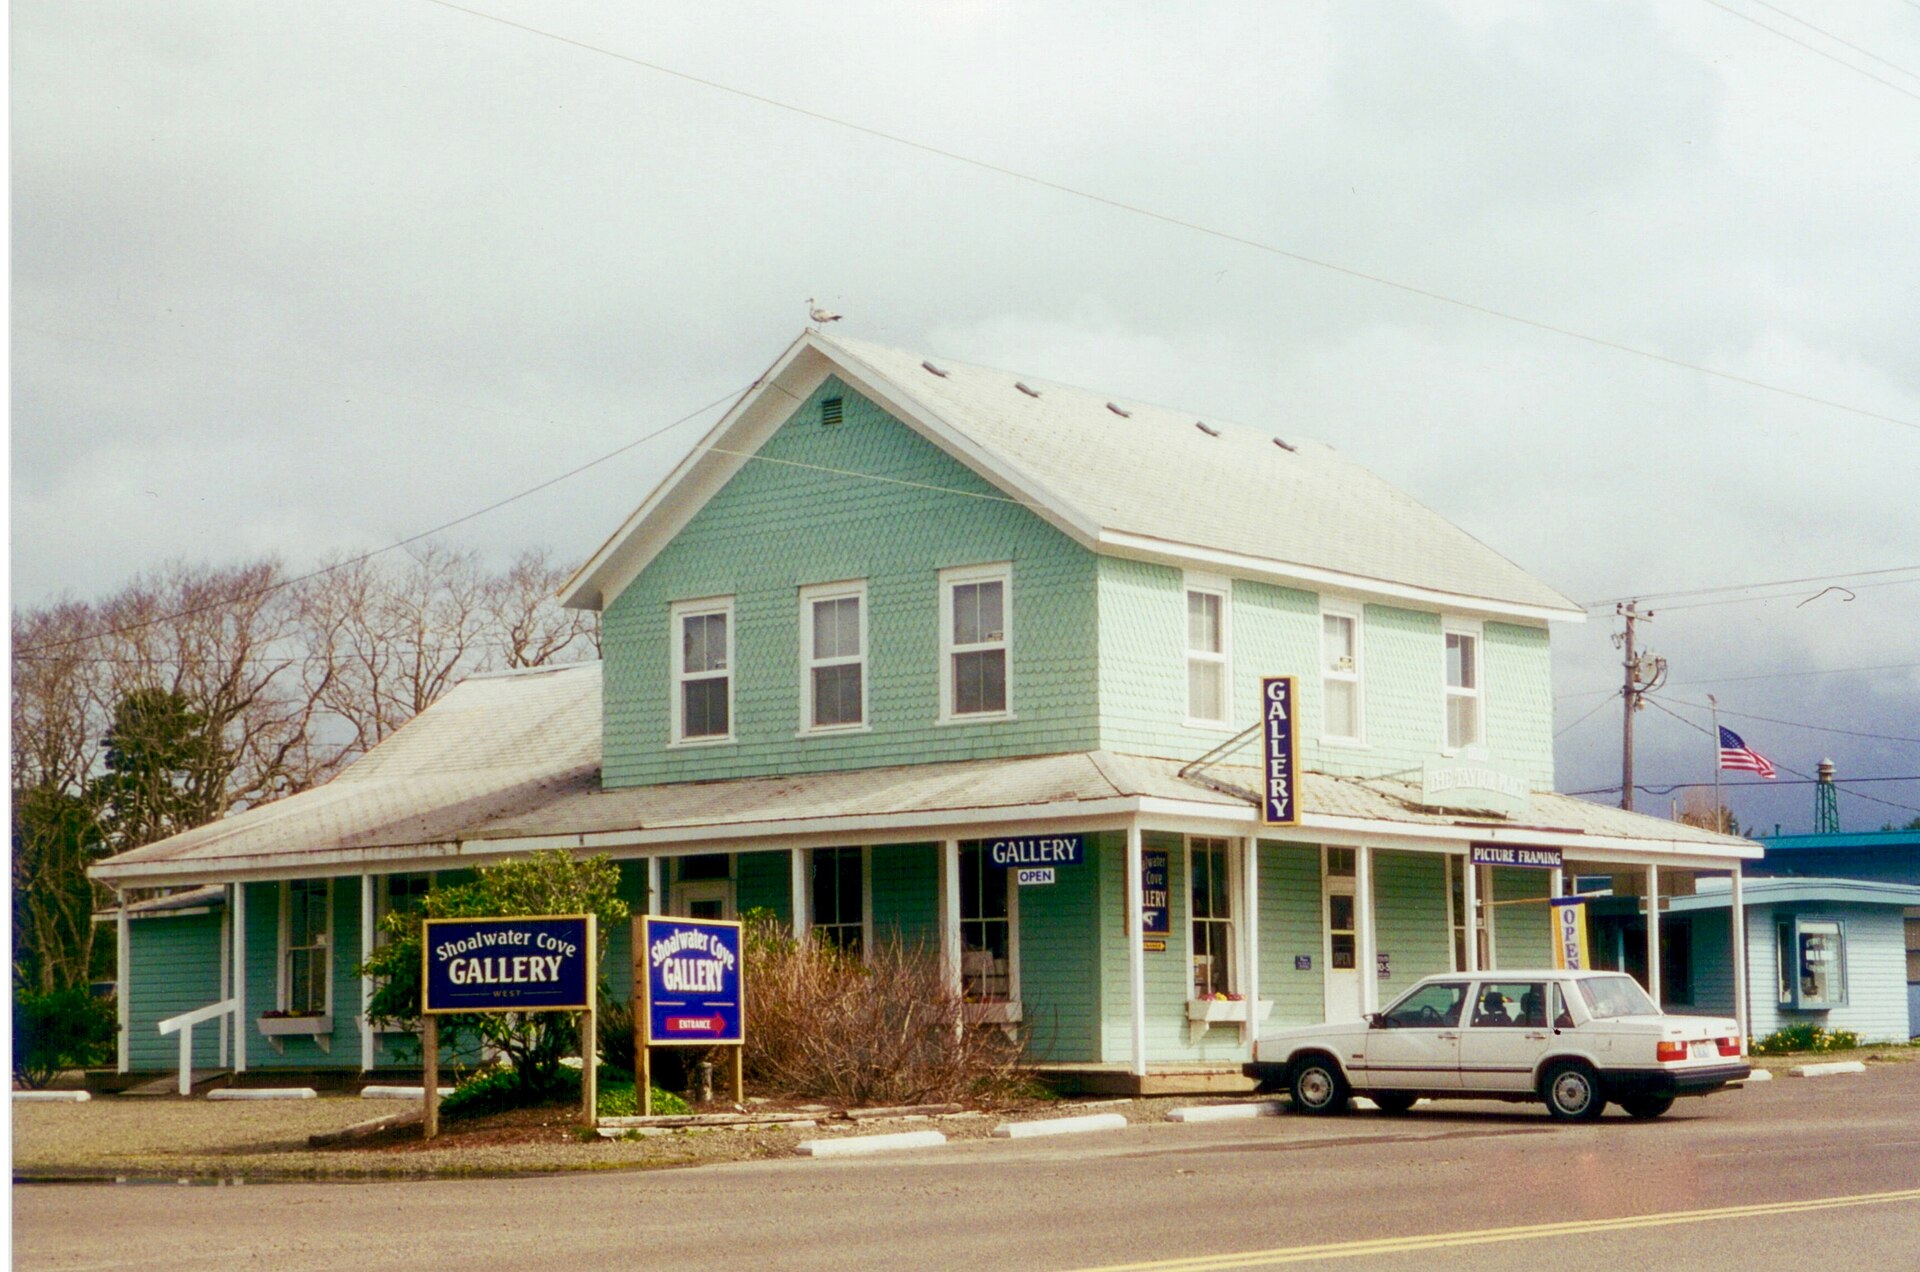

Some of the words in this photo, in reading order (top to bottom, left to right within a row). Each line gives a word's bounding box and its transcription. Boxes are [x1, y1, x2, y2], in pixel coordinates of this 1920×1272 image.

[1266, 681, 1289, 818] GALLERY
[992, 838, 1077, 864] GALLERY
[1474, 847, 1515, 863] PICTURE
[1518, 850, 1561, 865] FRAMING
[1019, 870, 1052, 882] OPEN
[436, 929, 532, 962] Shoalwater
[536, 932, 577, 958] Cove
[651, 928, 709, 968] Shoalwater
[710, 935, 735, 971] Cove
[448, 955, 563, 985] GALLERY
[663, 958, 724, 992] GALLERY
[492, 989, 522, 998] WEST
[678, 1019, 712, 1030] ENTRANCE
